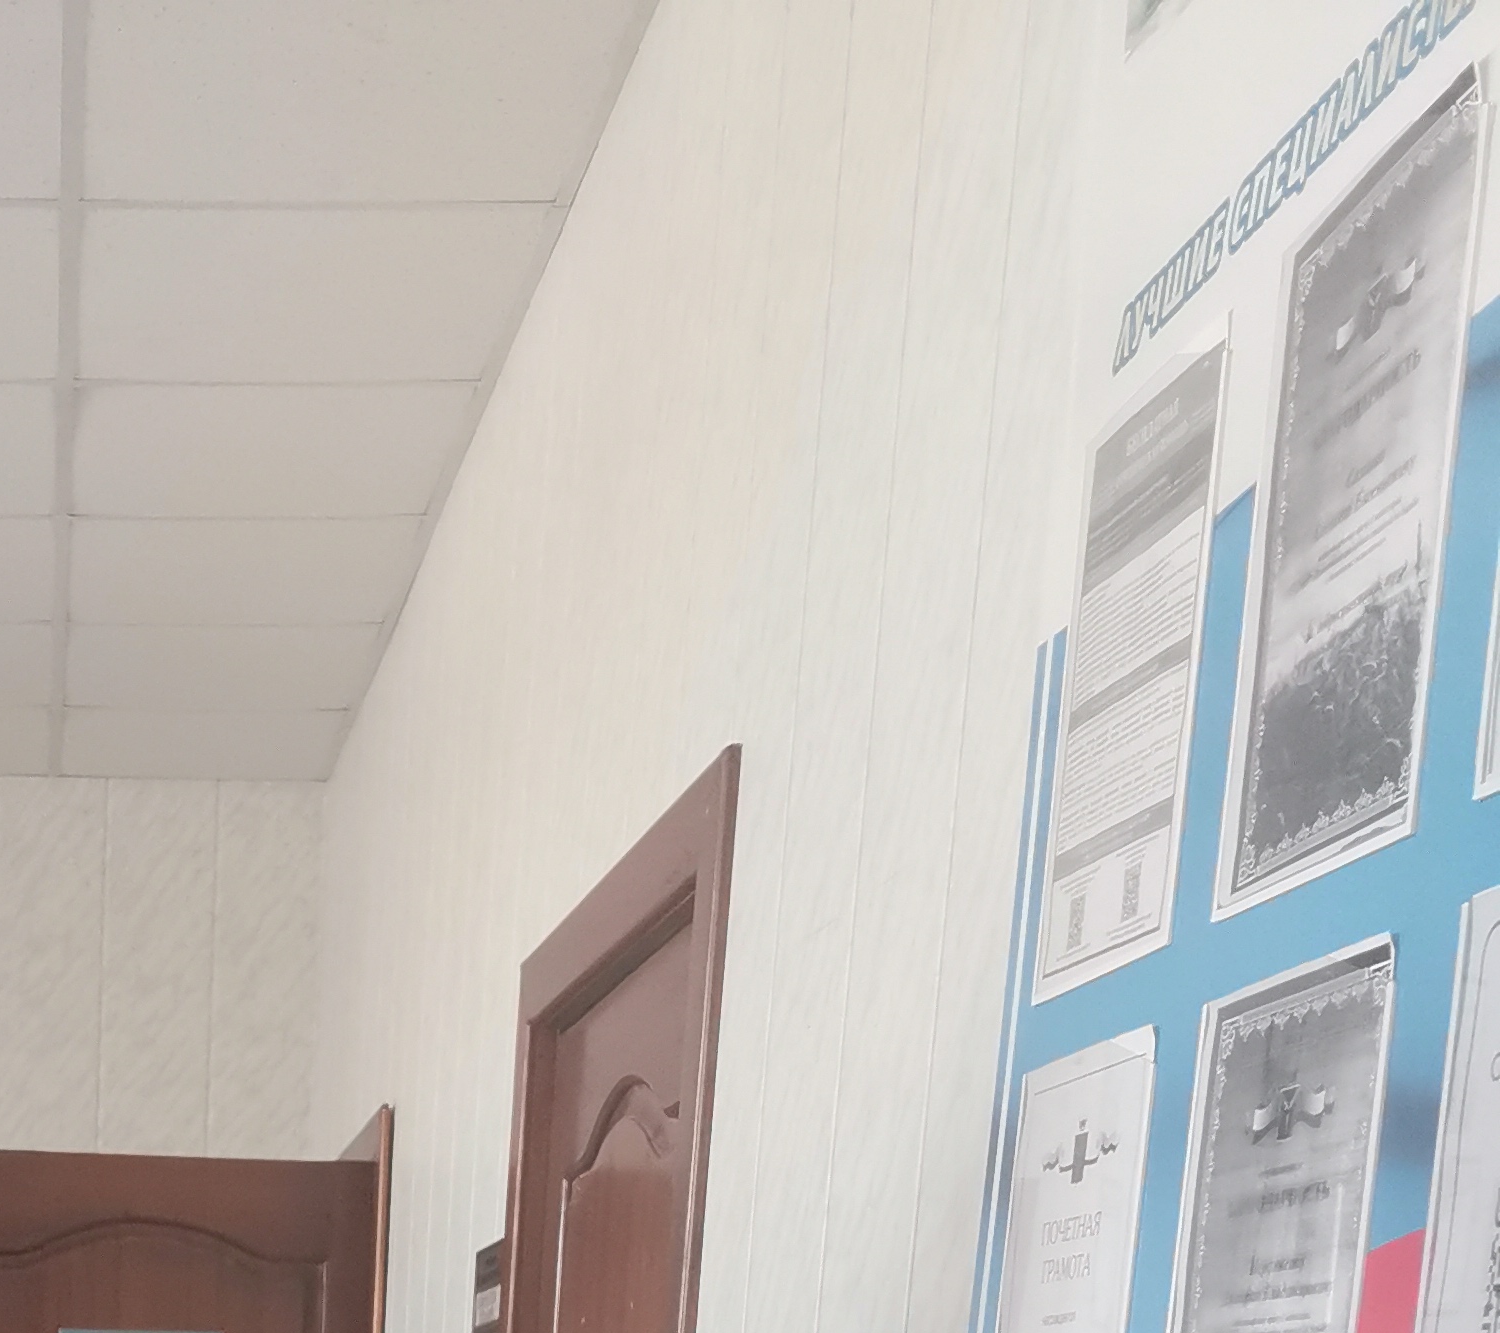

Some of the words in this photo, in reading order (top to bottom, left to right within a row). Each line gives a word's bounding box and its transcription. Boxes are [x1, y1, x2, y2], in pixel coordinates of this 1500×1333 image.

[1112, 197, 1231, 377] ЛУЧШИЕ
[1041, 1211, 1102, 1246] ПОЧЕТНАЯ
[1041, 1253, 1090, 1284] ГРАМОТА
